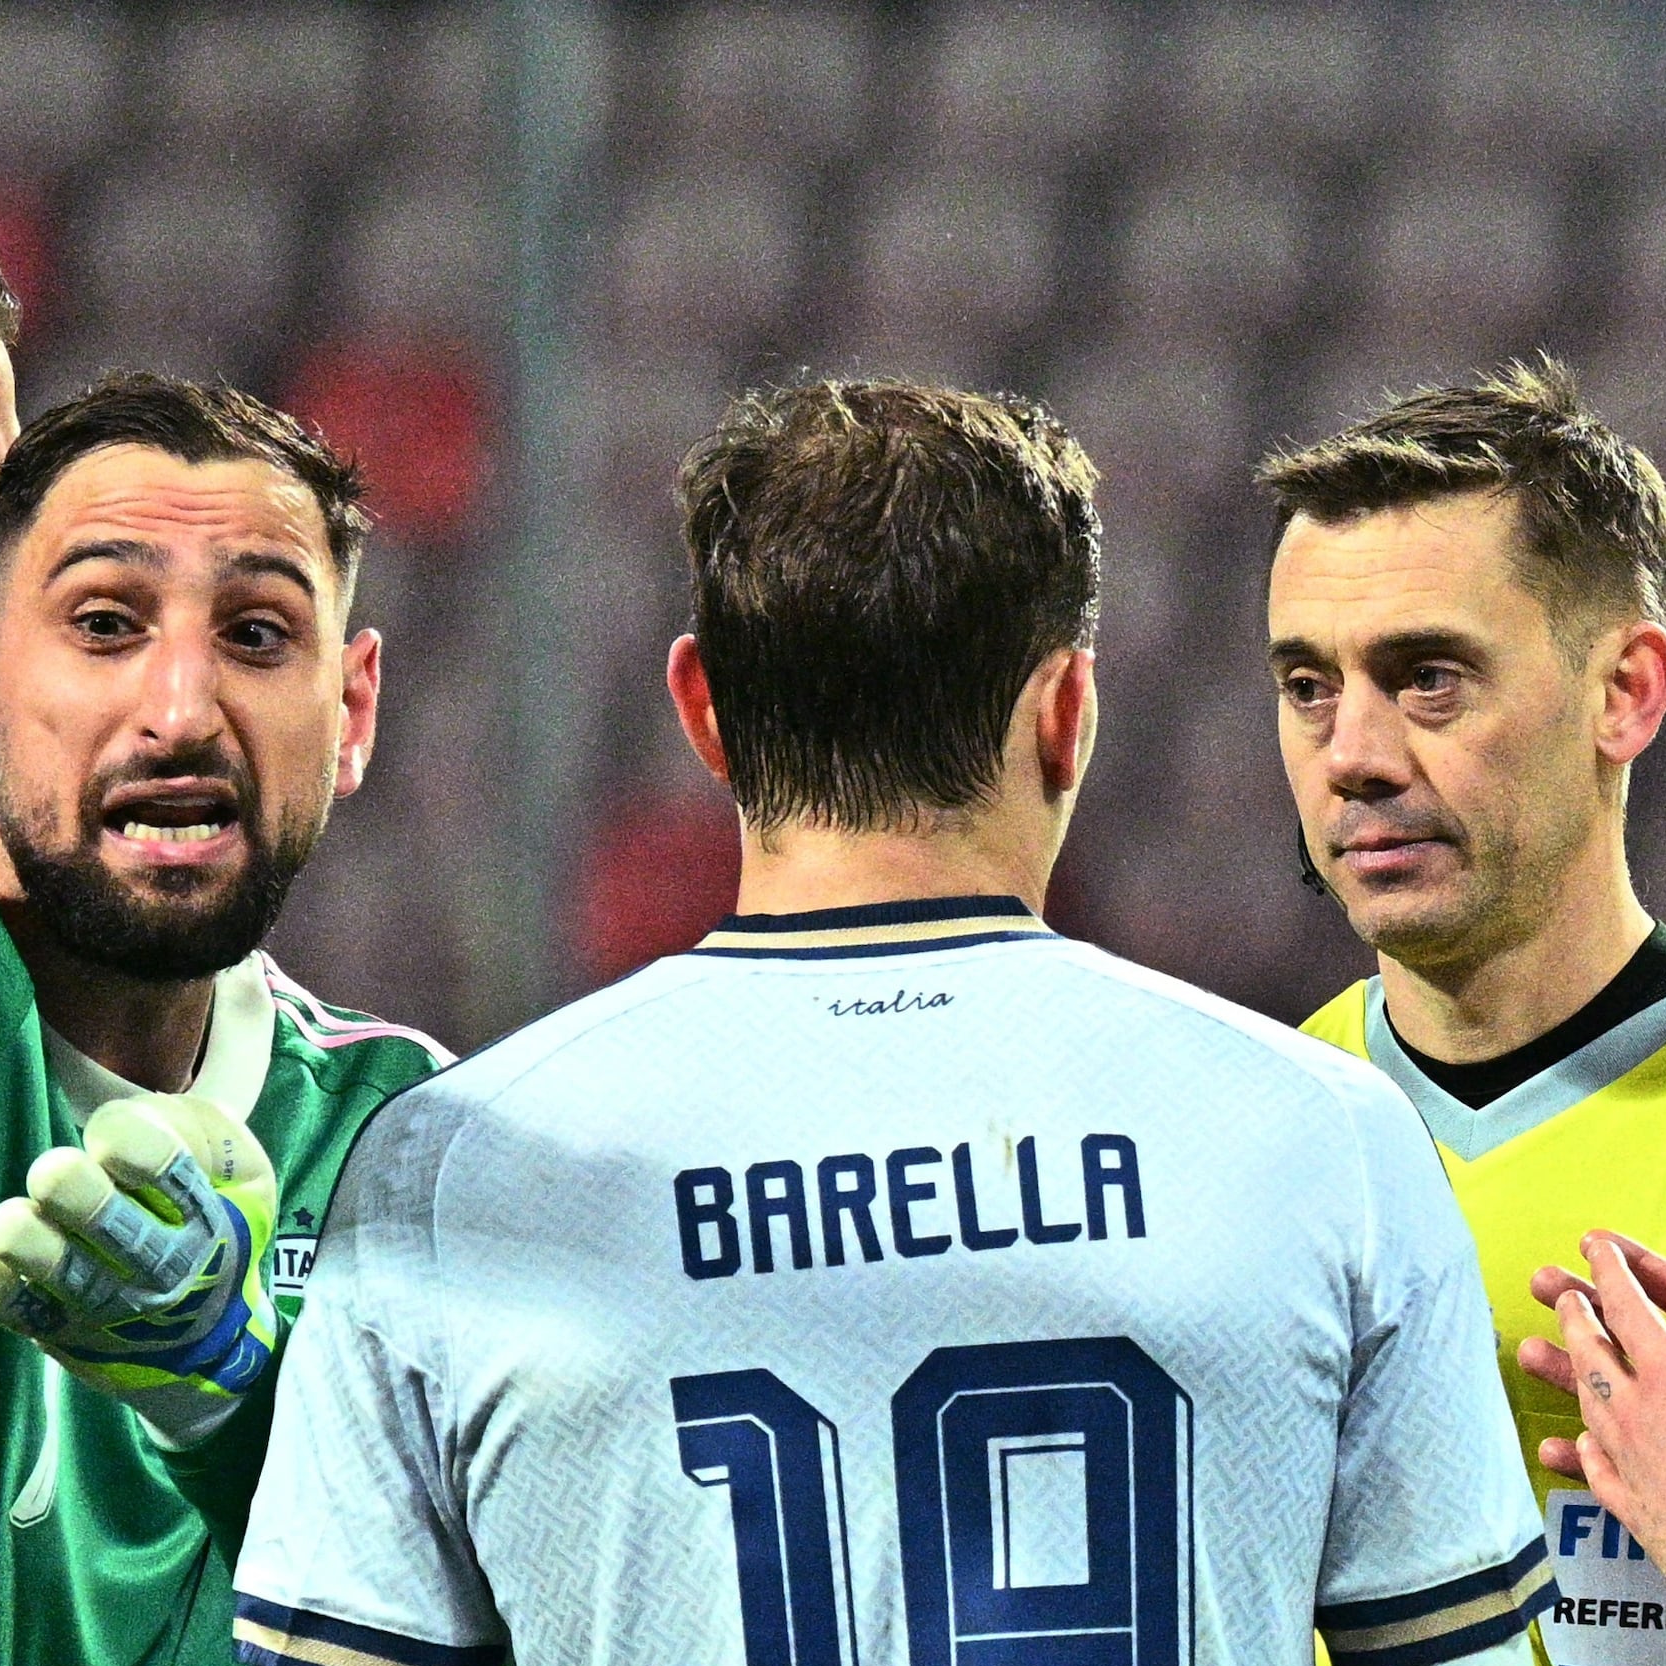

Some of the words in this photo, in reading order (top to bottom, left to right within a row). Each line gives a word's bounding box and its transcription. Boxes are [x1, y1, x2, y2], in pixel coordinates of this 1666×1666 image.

[826, 988, 956, 1017] italia
[673, 1132, 1147, 1281] BARELLA
[274, 1247, 315, 1278] ITA
[1559, 1504, 1645, 1561] FI
